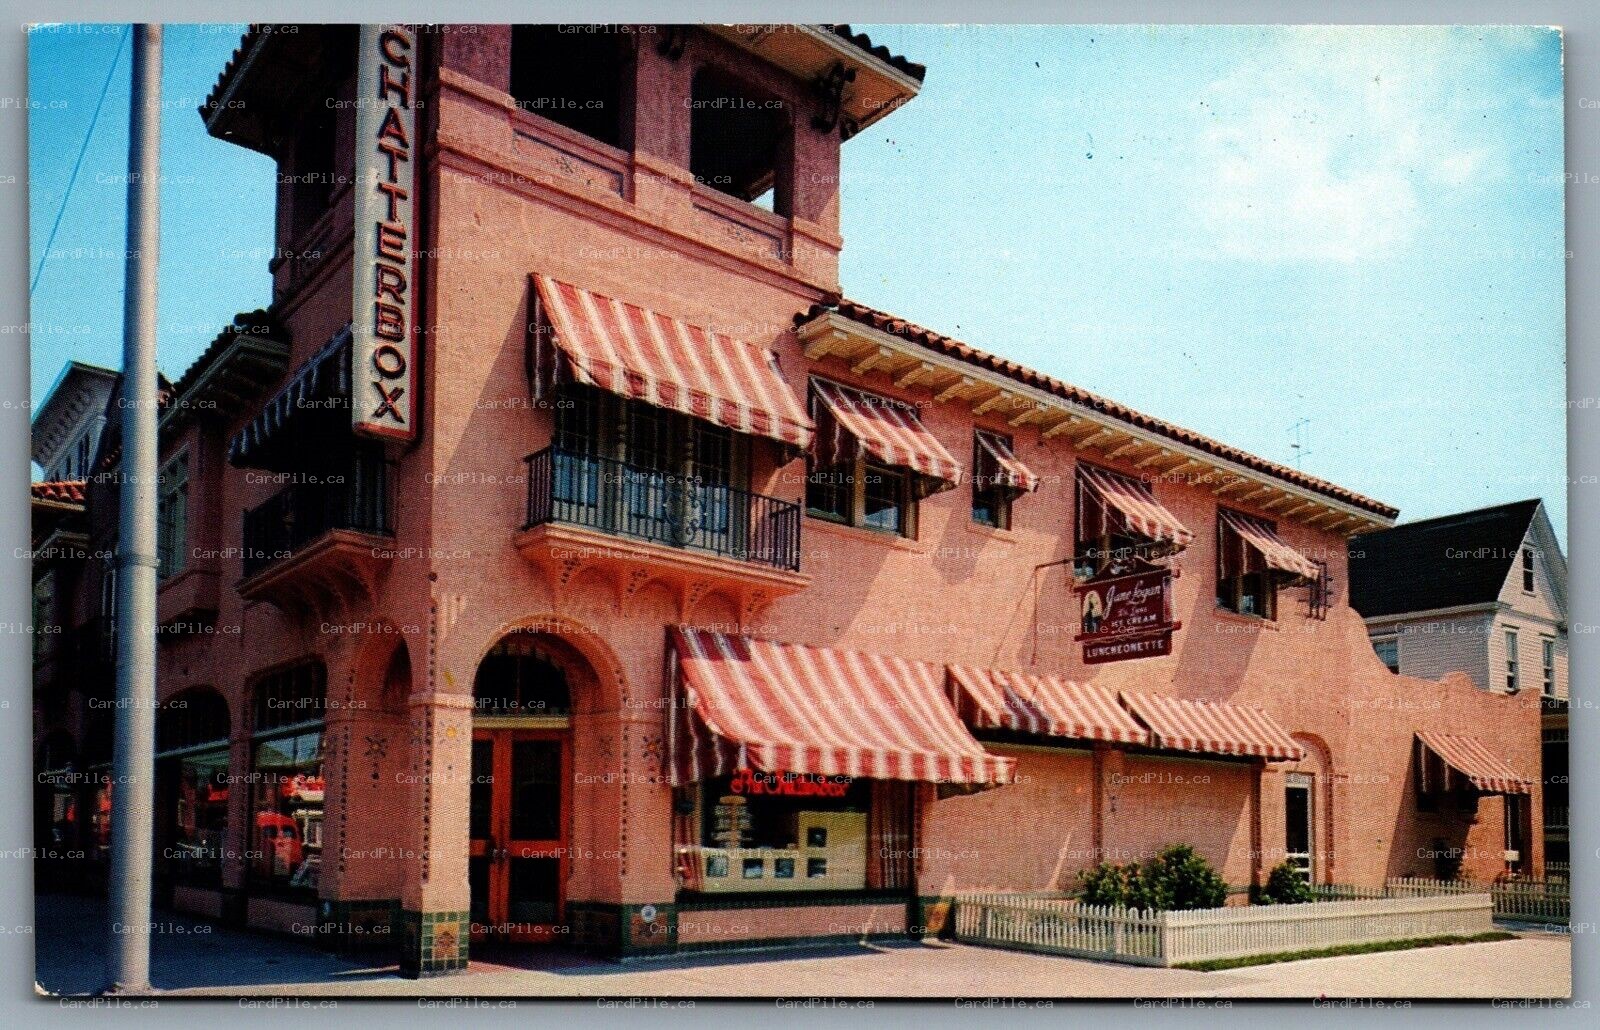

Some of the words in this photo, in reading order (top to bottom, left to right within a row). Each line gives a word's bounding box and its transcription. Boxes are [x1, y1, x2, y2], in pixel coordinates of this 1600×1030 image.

[372, 31, 412, 423] CHATTERBOX
[1126, 613, 1157, 625] CREAM
[1087, 639, 1164, 658] LUNCHEONETTE
